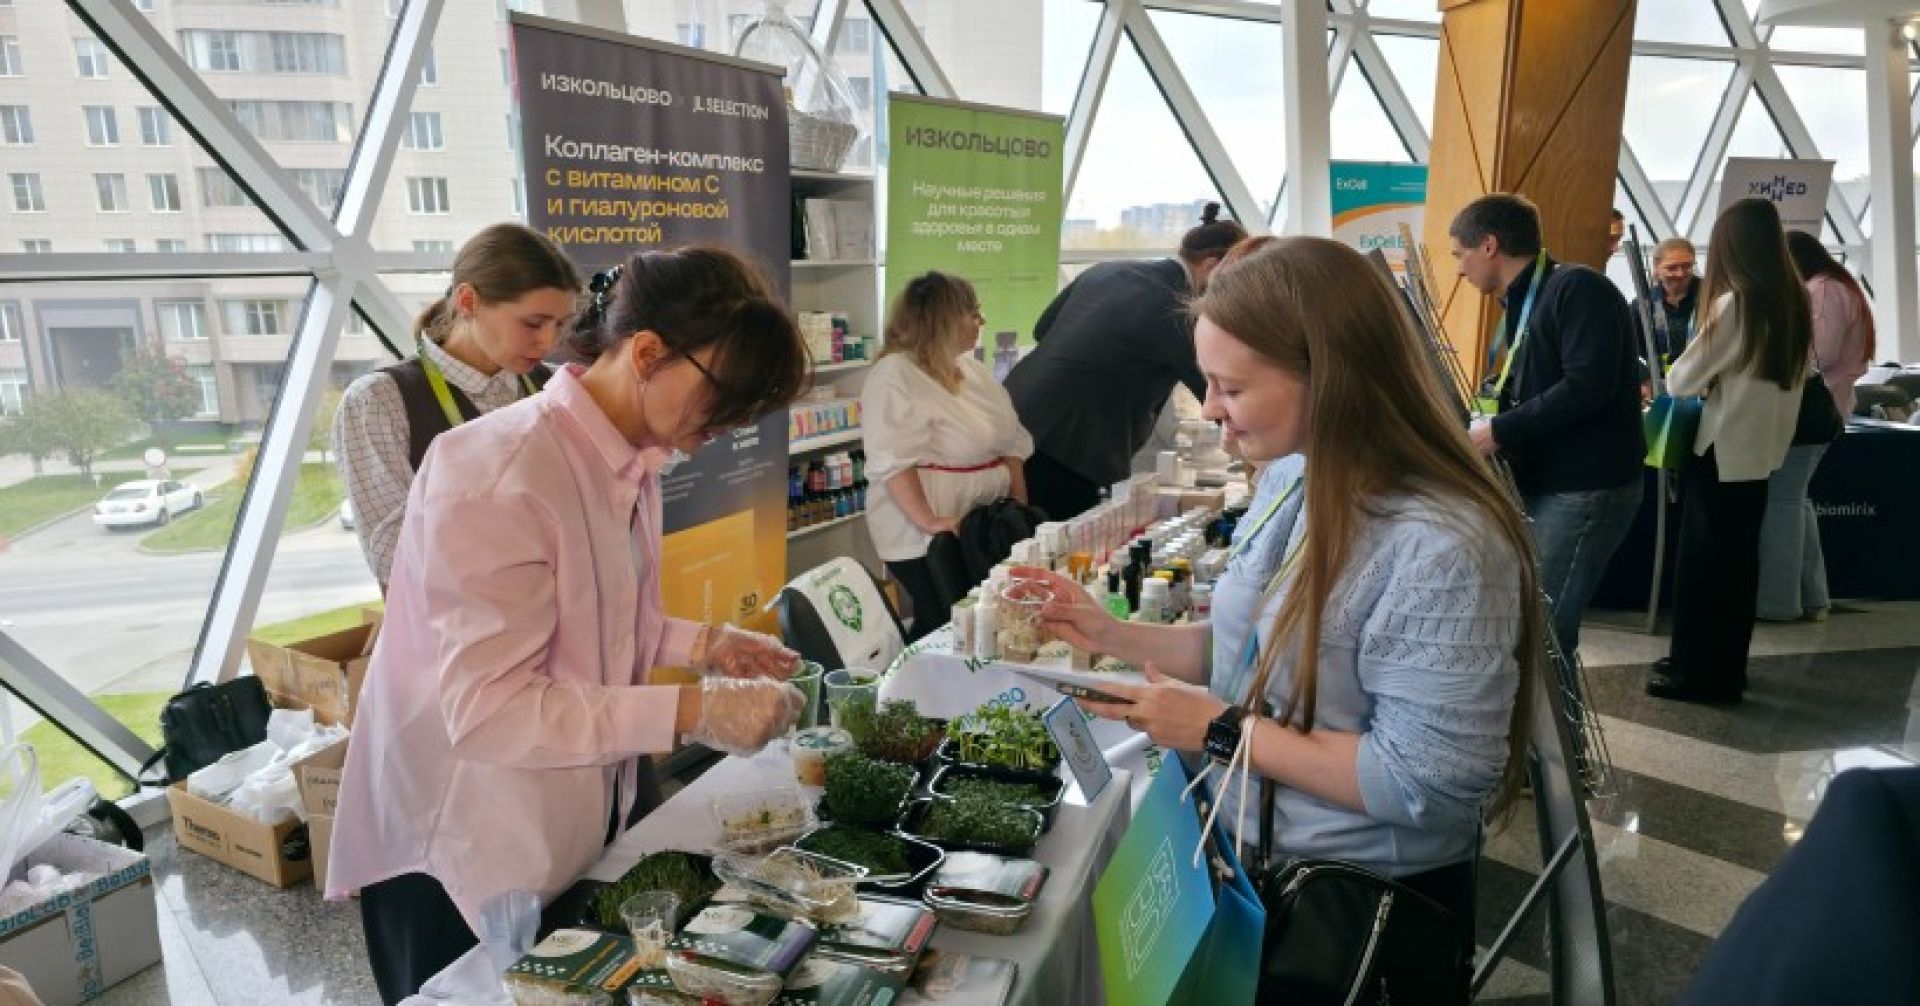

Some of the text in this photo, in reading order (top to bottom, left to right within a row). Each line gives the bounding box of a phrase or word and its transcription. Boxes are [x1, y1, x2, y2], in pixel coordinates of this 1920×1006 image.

[541, 72, 673, 106] ИЗКОЛЬЦОВО
[706, 98, 768, 120] SELECTION
[545, 133, 765, 174] Коллаген-комплекс
[905, 126, 1052, 159] ИЗКОЛЬЦОВО
[567, 170, 700, 193] витамином
[912, 180, 1046, 202] Научные решения
[1336, 177, 1367, 190] ExCell
[569, 199, 729, 221] гиалуроновой
[927, 203, 956, 218] для
[548, 222, 662, 244] кислотой
[911, 221, 982, 238] здоровья
[997, 224, 1041, 236] одном
[957, 240, 1003, 252] месте
[1360, 235, 1397, 250] ExCell
